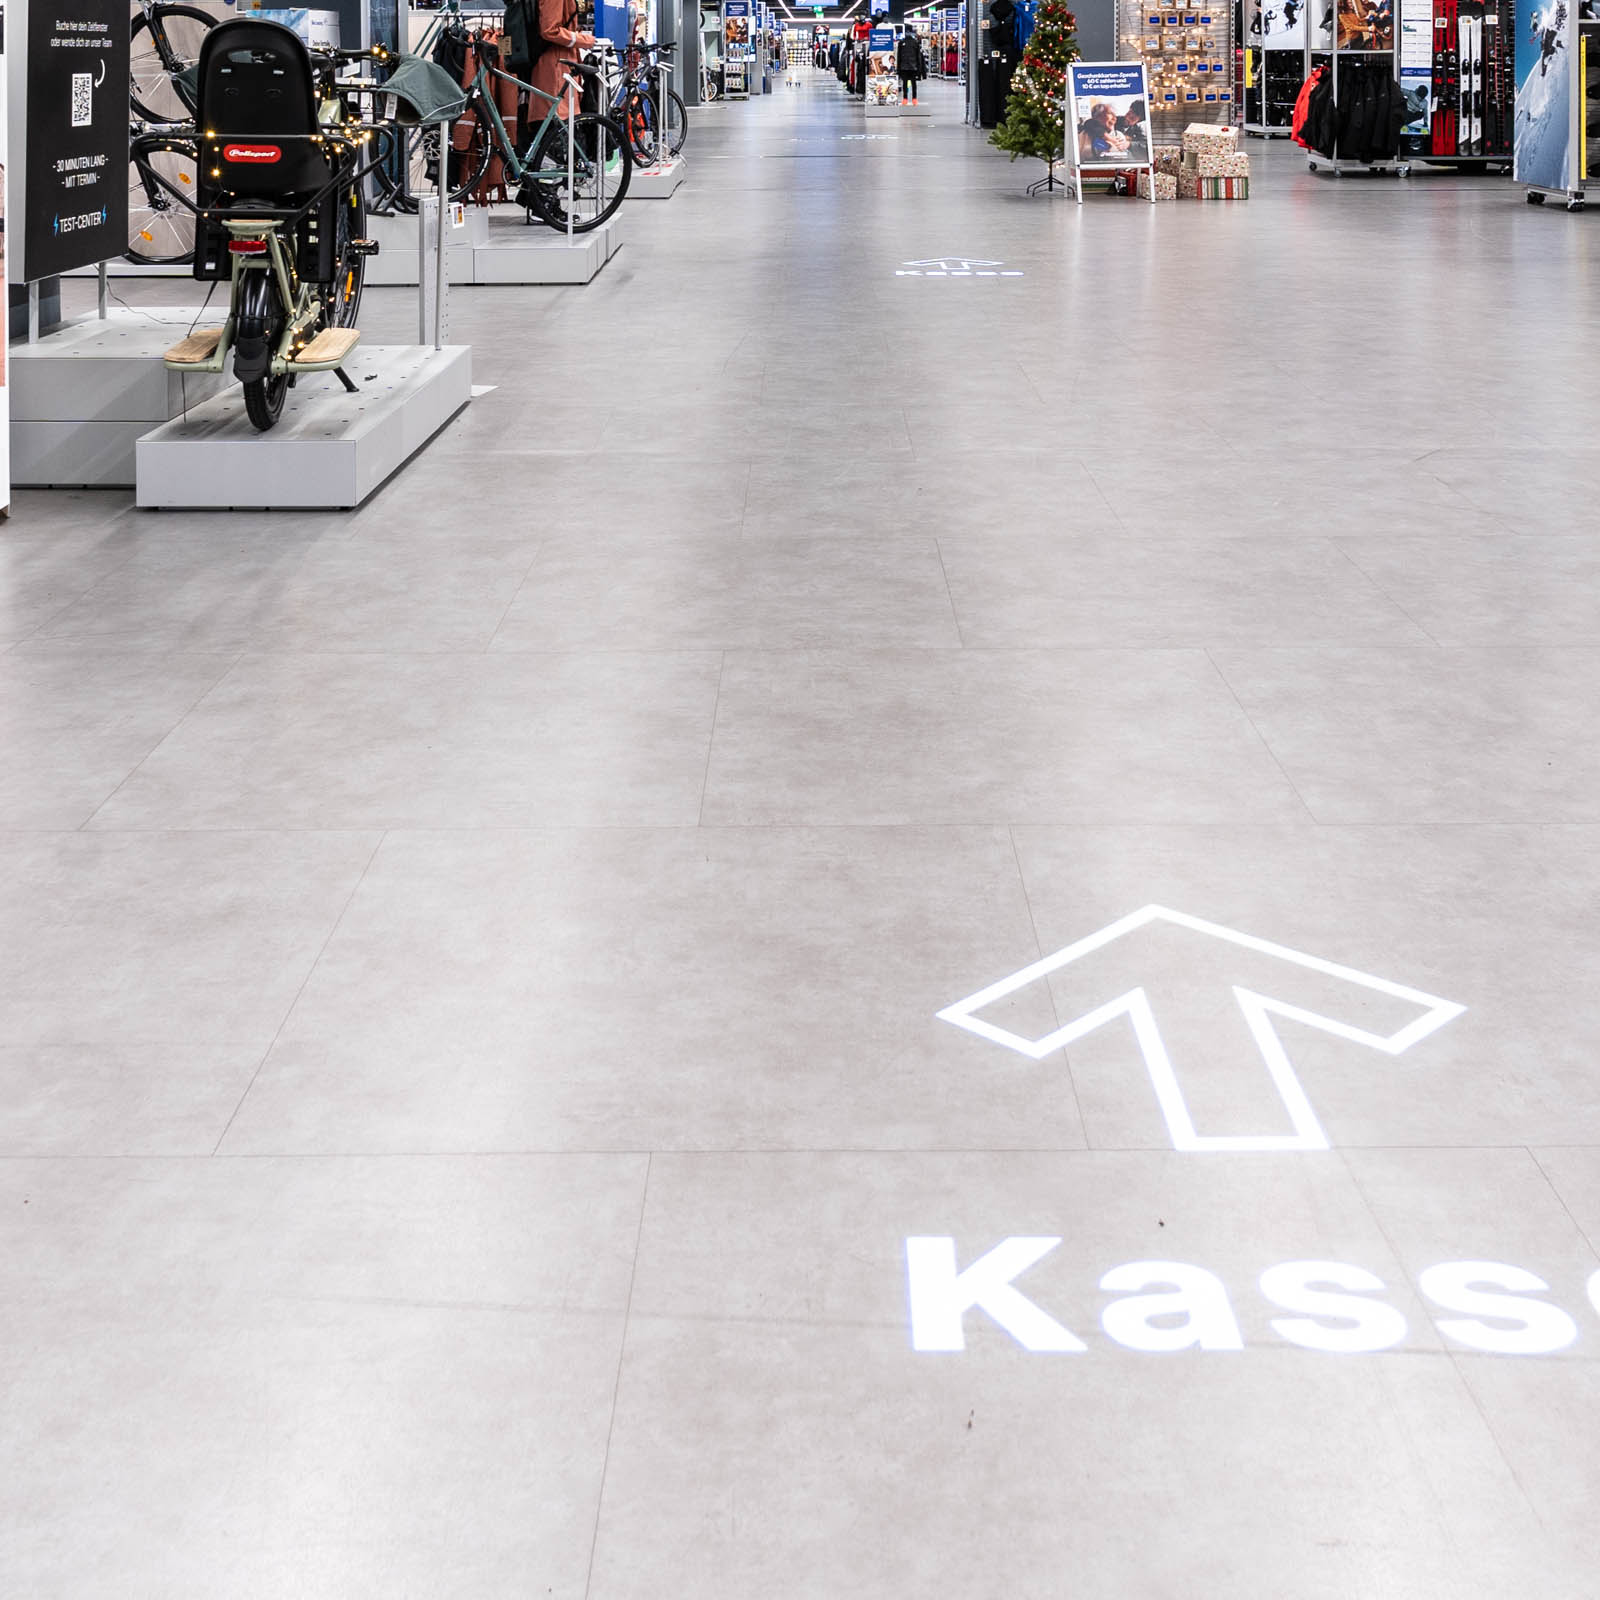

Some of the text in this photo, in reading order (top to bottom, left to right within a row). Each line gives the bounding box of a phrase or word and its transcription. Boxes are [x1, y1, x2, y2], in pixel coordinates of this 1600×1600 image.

[56, 154, 106, 173] 30 MINUTEN LANG
[65, 172, 97, 188] MIT TERMIN
[60, 211, 102, 233] TEST-CENTER
